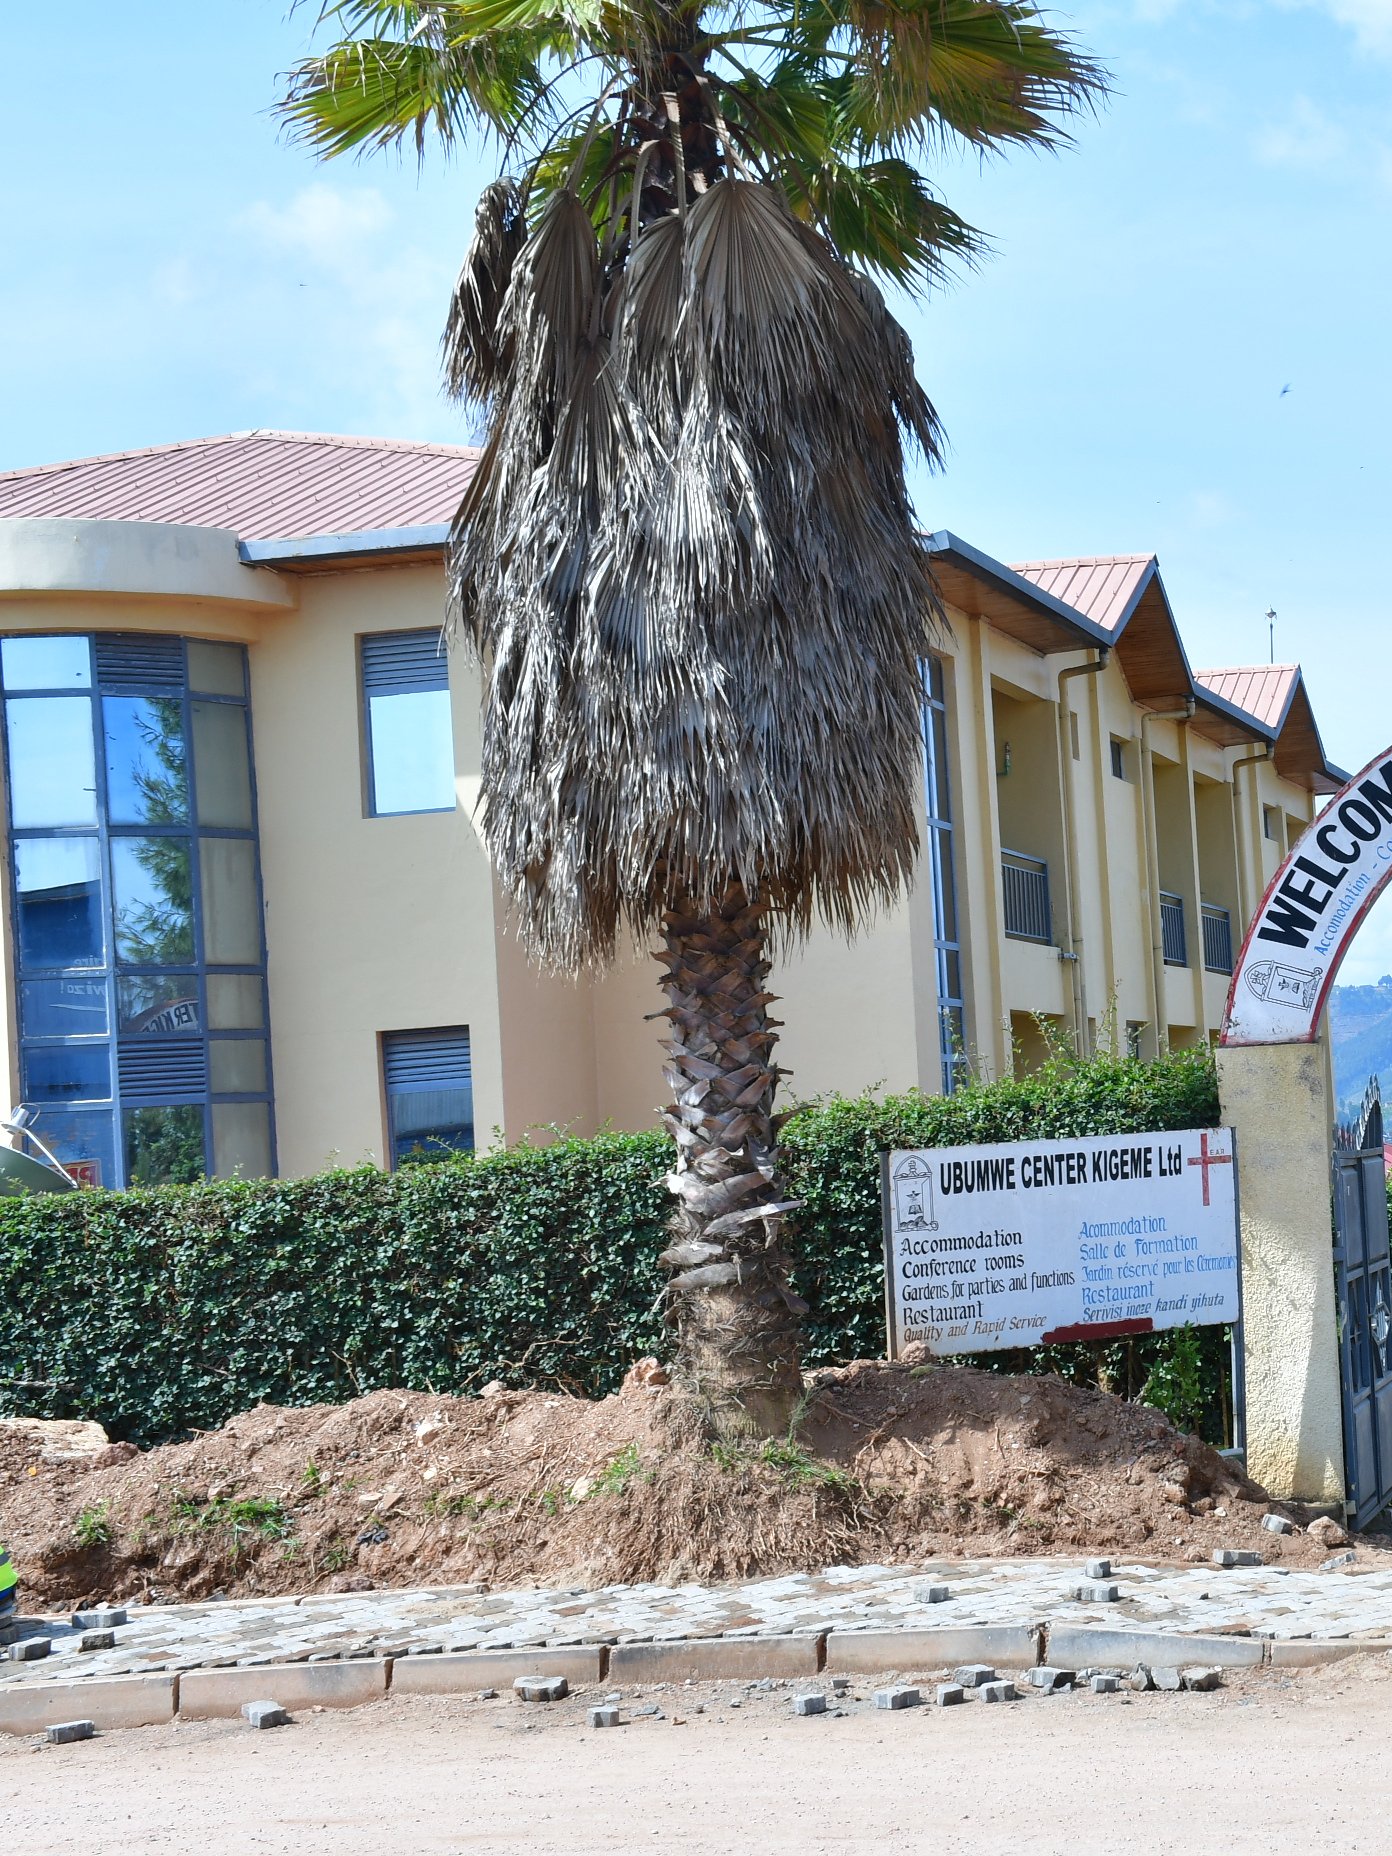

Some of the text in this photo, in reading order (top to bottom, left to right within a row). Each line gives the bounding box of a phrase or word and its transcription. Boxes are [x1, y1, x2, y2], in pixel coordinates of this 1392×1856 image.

[1313, 872, 1371, 956] Accomodation
[940, 1144, 1182, 1195] UBUMWE CENTER KIGEME Ltd
[1078, 1215, 1167, 1239] Acommodation
[900, 1229, 1023, 1256] Accommodation
[1080, 1235, 1198, 1261] Salle de Formation
[902, 1253, 1025, 1280] Conference rooms
[1082, 1264, 1113, 1282] Jardin
[1118, 1259, 1159, 1279] réservé
[1163, 1260, 1182, 1278] pour
[1184, 1256, 1195, 1272] les
[902, 1269, 1076, 1302] Gardens for parties and functions
[1082, 1281, 1155, 1305] Restaurant
[903, 1301, 984, 1326] Restaurant
[1083, 1303, 1123, 1322] Serivisi
[1155, 1294, 1188, 1313] kandi
[1190, 1293, 1225, 1312] yihuta
[904, 1313, 1047, 1342] Quality and Rapid Service
